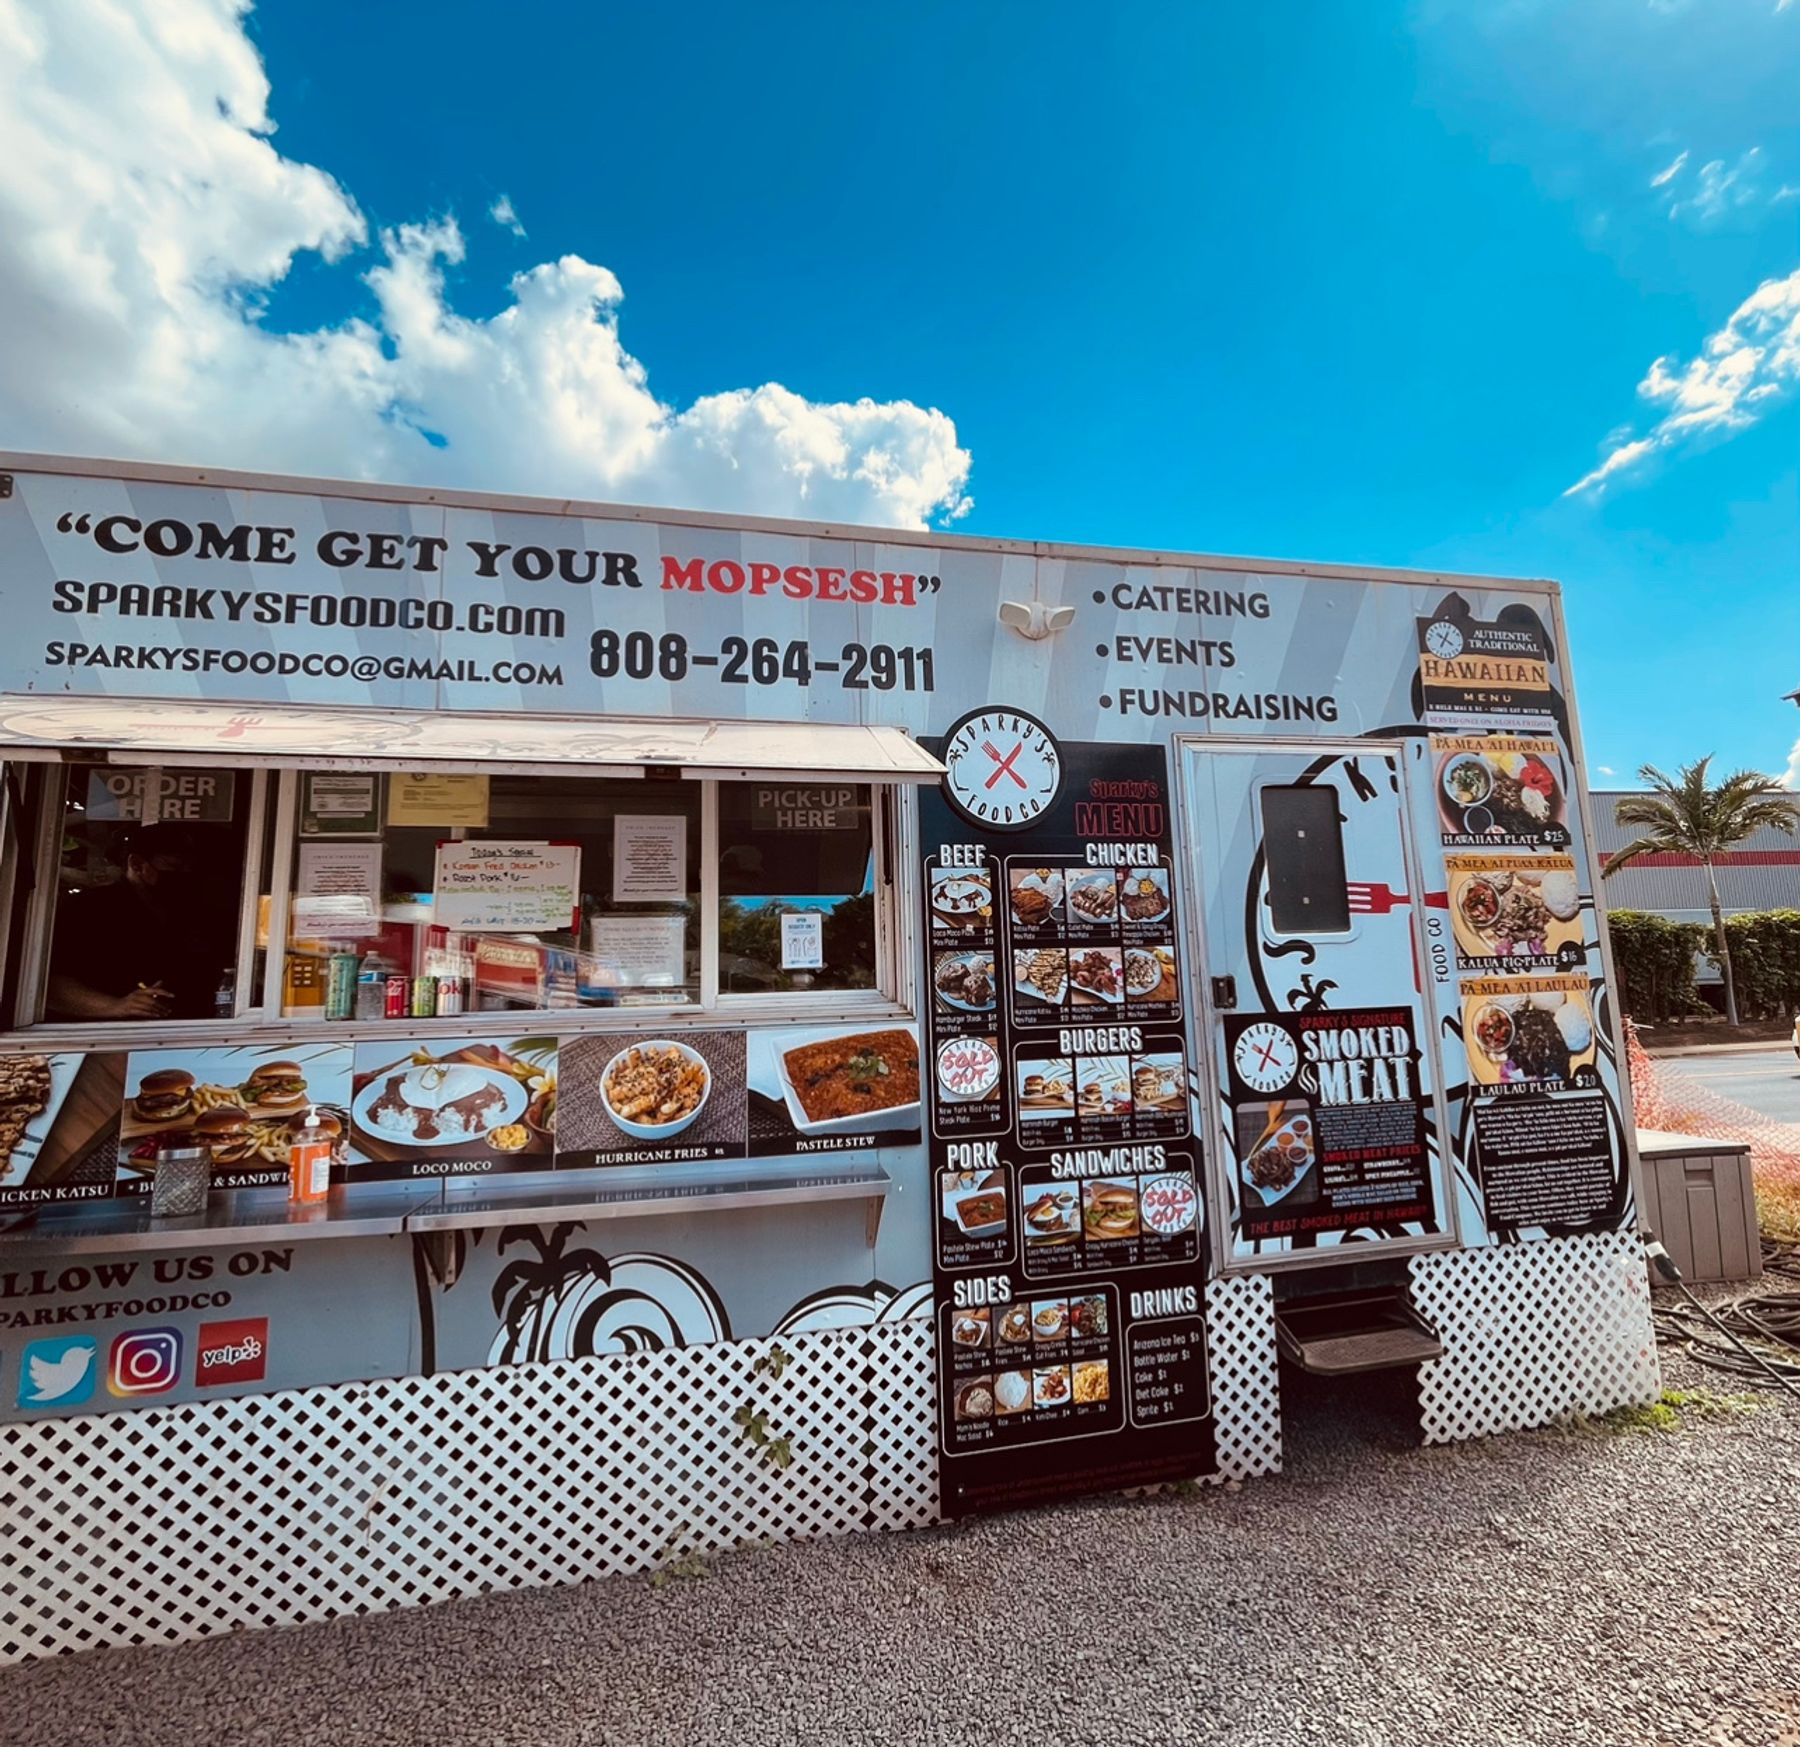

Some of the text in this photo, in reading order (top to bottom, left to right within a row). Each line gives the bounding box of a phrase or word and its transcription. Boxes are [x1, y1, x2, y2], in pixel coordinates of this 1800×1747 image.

[317, 532, 447, 571] GET
[467, 541, 642, 588] YOUR
[1111, 583, 1270, 618] CATERING
[1468, 639, 1539, 652] TRADITIONAL
[1473, 629, 1533, 642] AUTHENTIC
[590, 629, 934, 692] 808-264-2911
[1116, 636, 1235, 667] EVENTS
[45, 642, 563, 685] SPARKYSFOODCO@GMAIL.COM
[1424, 659, 1546, 684] HAWAIIAN
[1119, 688, 1337, 722] FUNDRAISING
[1464, 693, 1512, 703] MENU
[758, 790, 852, 808] PICK-UP
[1089, 778, 1158, 799] Sparky's
[120, 798, 201, 819] HRE
[967, 794, 1013, 822] FOOD
[776, 810, 836, 828] HERE
[1075, 802, 1164, 837] MENU
[1444, 834, 1501, 845] HAWAIIAN
[1504, 834, 1540, 844] PLATE
[940, 844, 986, 867] BEEF
[1086, 842, 1159, 866] CHICKEN
[1427, 918, 1450, 983] FOOD CO
[1458, 958, 1499, 969] KALUA
[1502, 957, 1524, 968] PIG
[1525, 955, 1560, 967] PLATE
[1480, 981, 1511, 994] MEA
[1536, 978, 1588, 992] LAULAU
[1352, 1012, 1405, 1027] SIGNATURE
[1059, 1027, 1143, 1055] BURGERS
[1302, 1026, 1411, 1062] SMOKED
[943, 1050, 994, 1070] SOLD
[950, 1067, 989, 1088] OUT
[1317, 1057, 1413, 1106] MEAT
[1480, 1074, 1596, 1097] LAULAU PLATE $20
[939, 1106, 952, 1115] New
[954, 1105, 967, 1114] York
[796, 1135, 876, 1152] PASTELE STEW
[595, 1149, 672, 1164] HURRICANE
[674, 1148, 708, 1160] FRIES
[947, 1141, 1000, 1170] PORK
[1051, 1145, 1167, 1178] SANDWICHES
[412, 1160, 492, 1175] LOCO MOCO
[56, 1185, 109, 1199] KATSU
[1145, 1190, 1193, 1207] SOLD
[1151, 1207, 1186, 1226] OUT
[1250, 1222, 1269, 1234] THE
[1273, 1218, 1298, 1232] BEST
[1301, 1213, 1342, 1230] SMOKED
[1344, 1210, 1371, 1226] MEAT
[964, 1241, 980, 1251] Stew
[154, 1256, 214, 1283] US
[228, 1248, 295, 1277] ON
[954, 1275, 1012, 1308] SIDES
[1130, 1286, 1198, 1318] DRINKS
[1133, 1338, 1160, 1350] Arizona
[1160, 1336, 1172, 1347] Ice
[1173, 1333, 1186, 1345] Tea
[203, 1346, 243, 1367] yelp
[1134, 1352, 1179, 1367] Bottle Water
[1134, 1371, 1153, 1384] Coke
[1135, 1386, 1169, 1400] Diet Coke
[1136, 1403, 1159, 1418] Sprite
